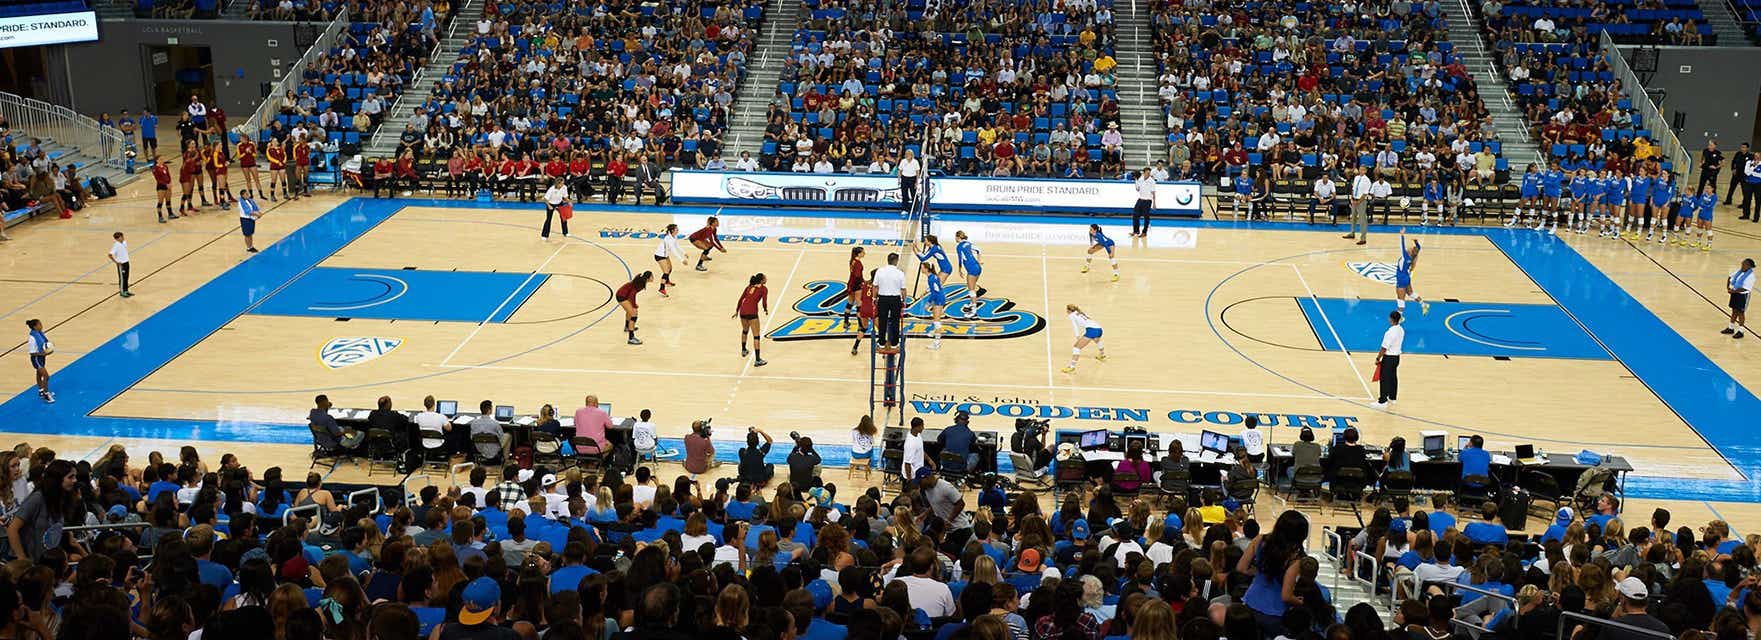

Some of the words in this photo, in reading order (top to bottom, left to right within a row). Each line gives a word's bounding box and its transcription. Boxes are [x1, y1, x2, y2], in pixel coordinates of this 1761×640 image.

[985, 184, 1015, 194] BRUIN
[963, 395, 981, 403] &
[990, 397, 1040, 405] John
[909, 400, 1151, 422] WOODEN
[1167, 409, 1359, 429] COURT
